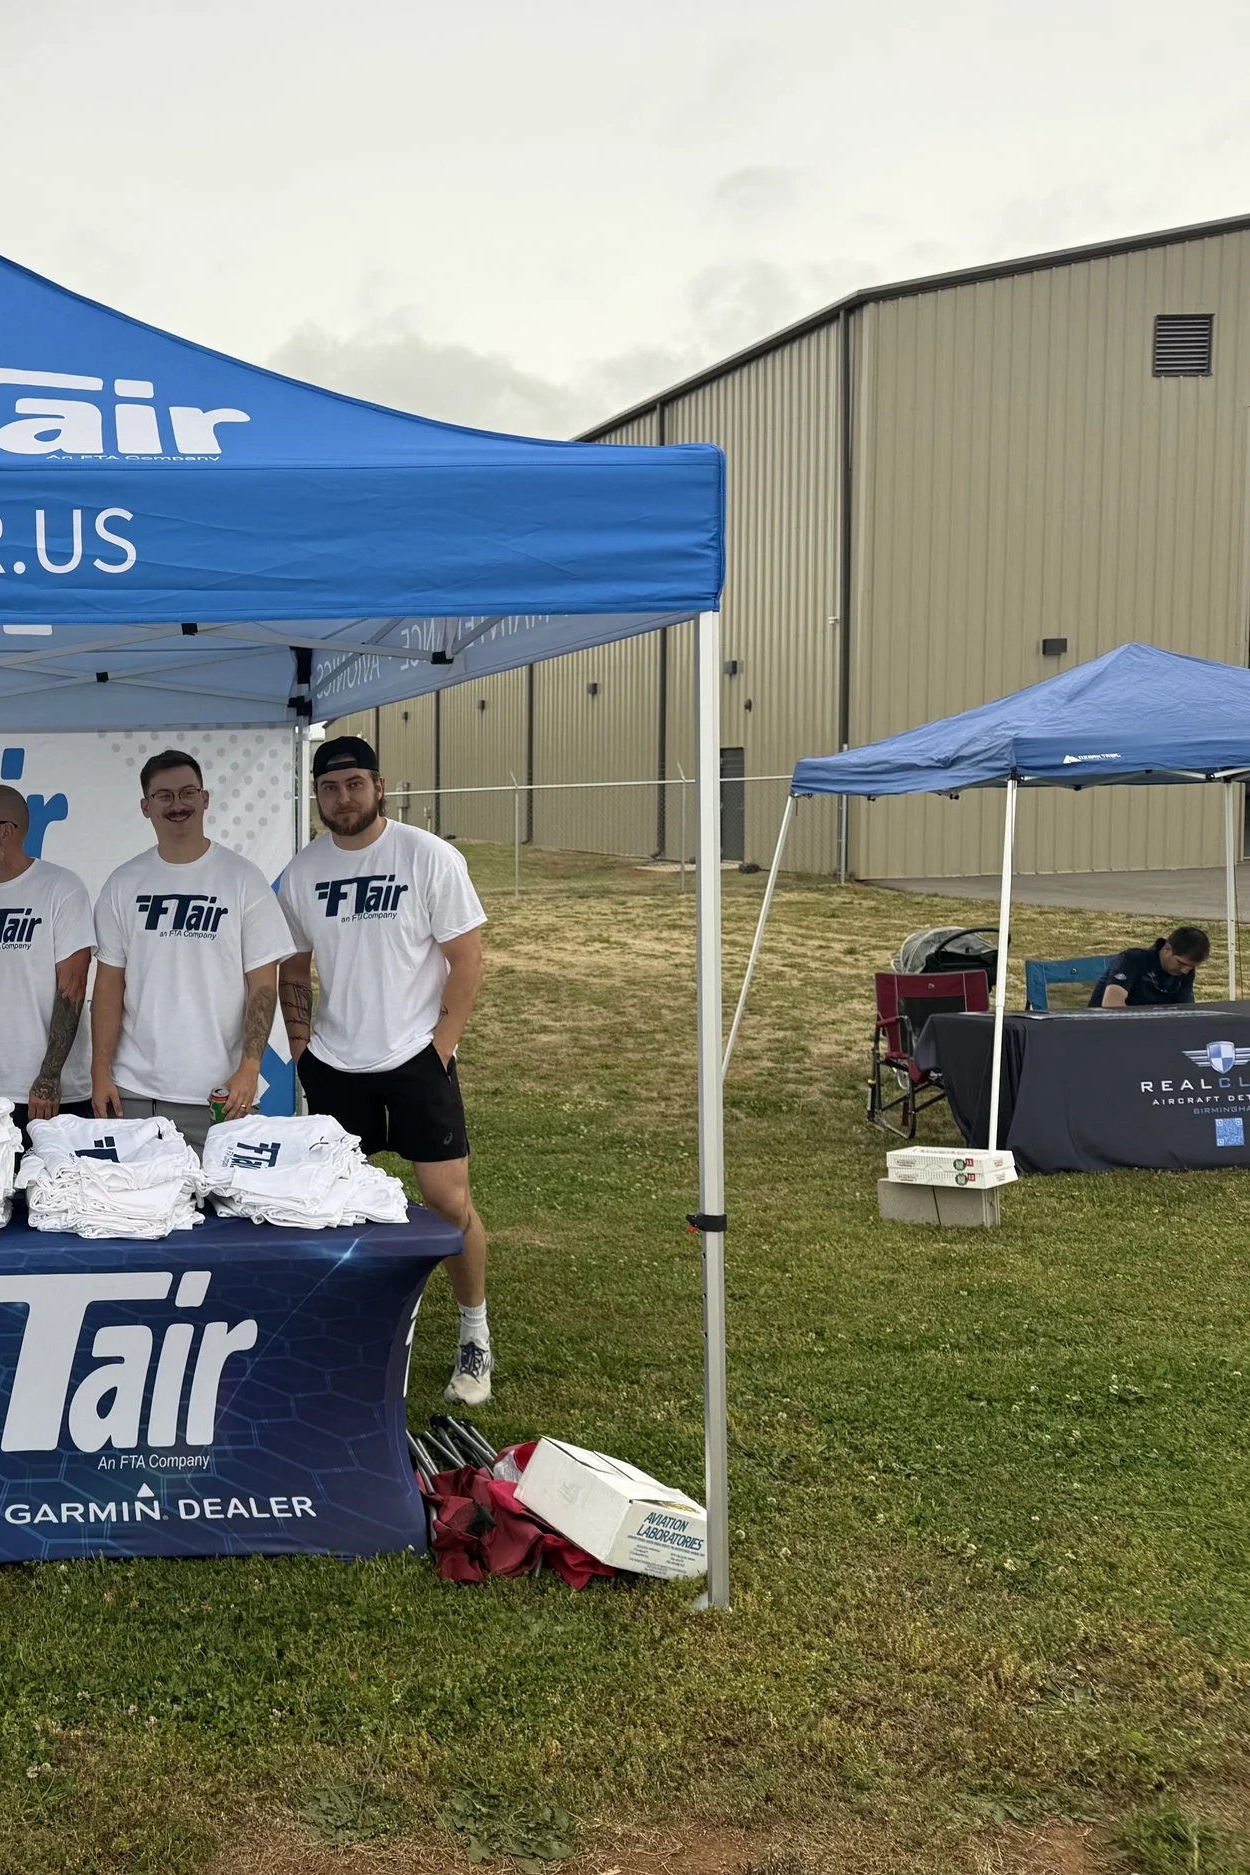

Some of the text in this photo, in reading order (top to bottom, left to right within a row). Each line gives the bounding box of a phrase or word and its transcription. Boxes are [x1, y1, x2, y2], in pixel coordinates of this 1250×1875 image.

[126, 454, 221, 463] Company
[315, 874, 409, 918] FTair
[136, 893, 229, 933] FTair
[183, 930, 217, 940] Company
[1, 942, 32, 951] Company
[1152, 1094, 1250, 1106] AIRCRAFT DET
[97, 1454, 210, 1471] An FTA Company
[179, 1496, 317, 1521] DEALER
[643, 1511, 690, 1533] AVIATION
[636, 1524, 705, 1551] LABORATORIES
